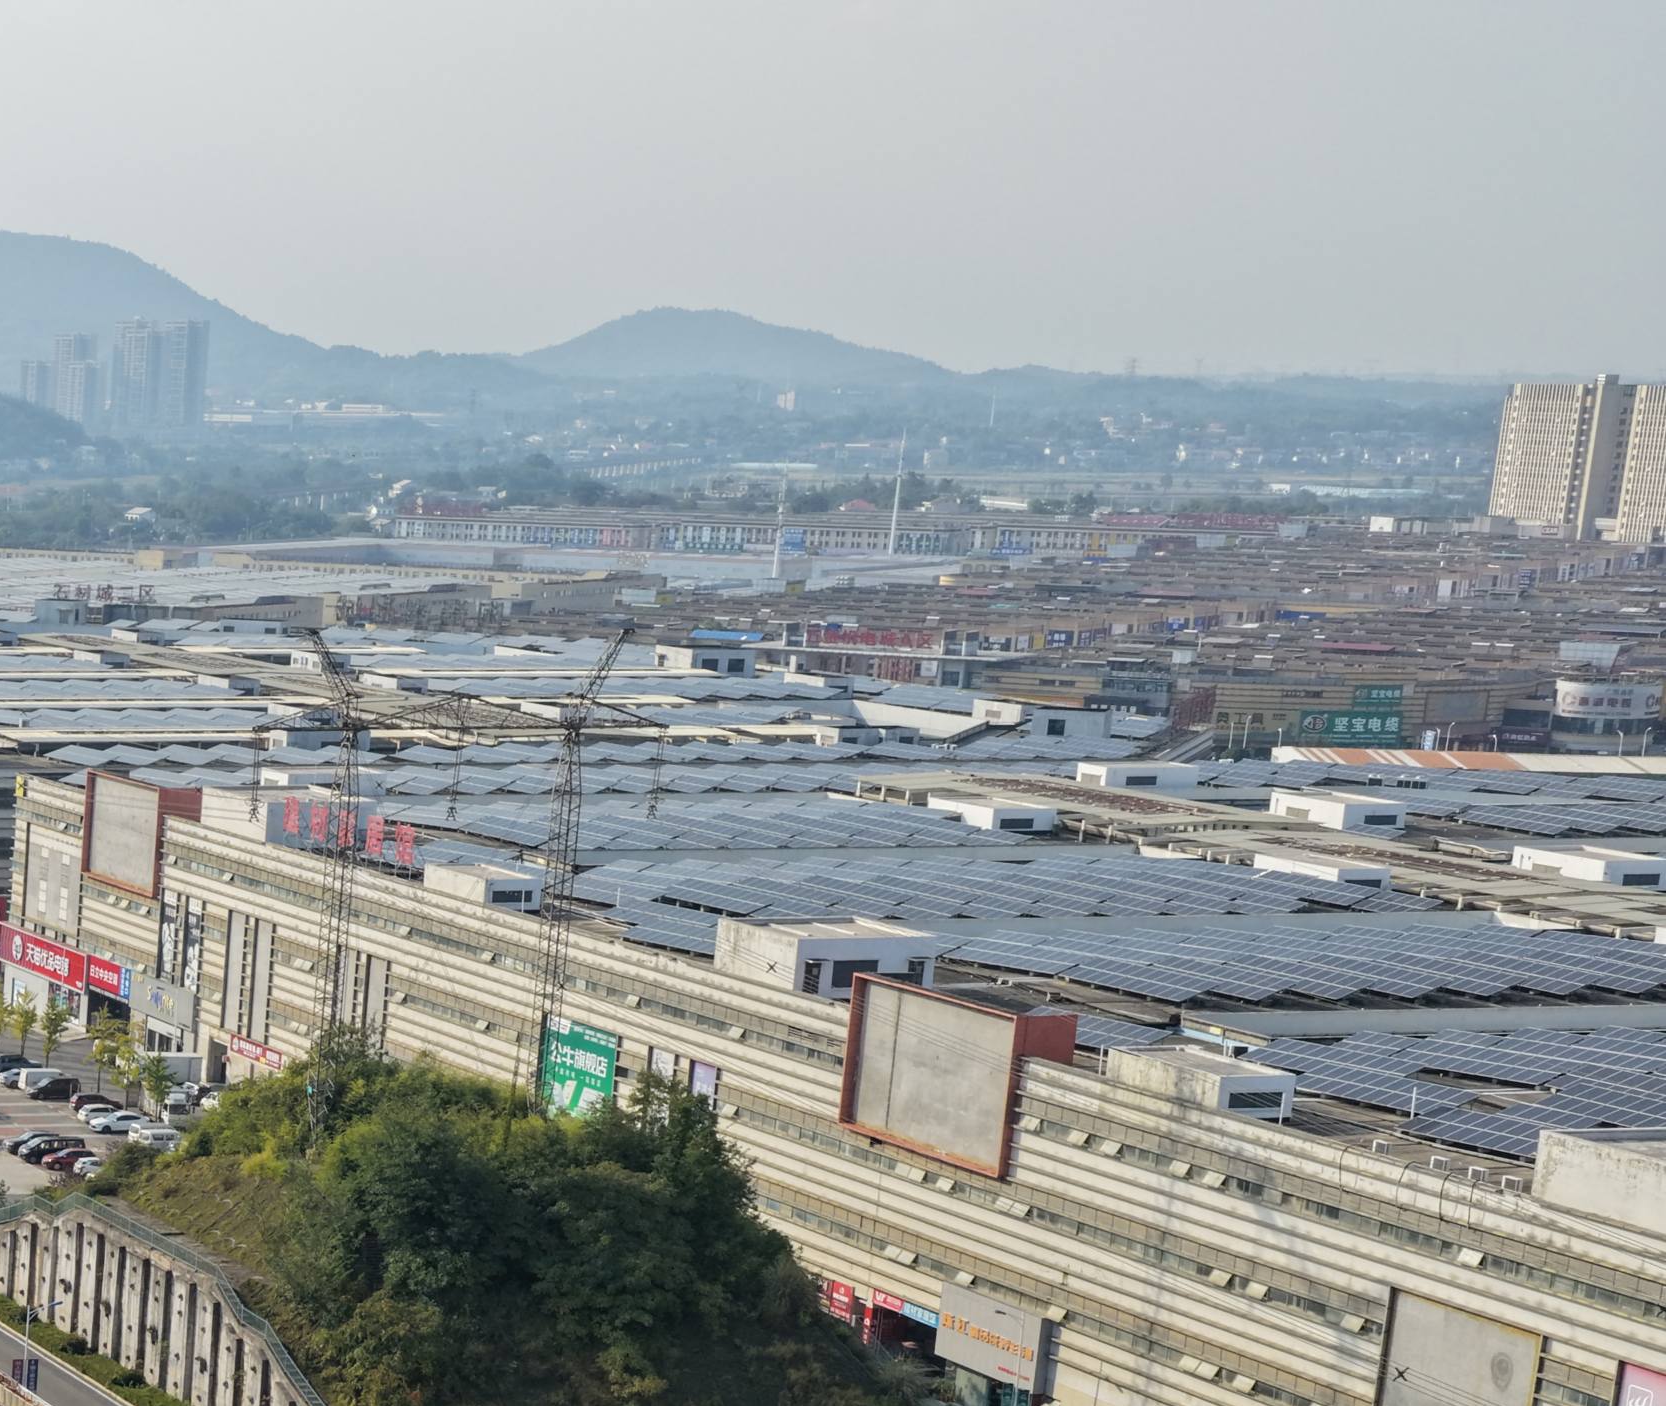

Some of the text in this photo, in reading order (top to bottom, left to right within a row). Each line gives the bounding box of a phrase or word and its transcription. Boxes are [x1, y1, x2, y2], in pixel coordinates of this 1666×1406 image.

[1333, 716, 1400, 733] 坚宝电缆
[550, 1040, 609, 1076] 公牛旗舰店
